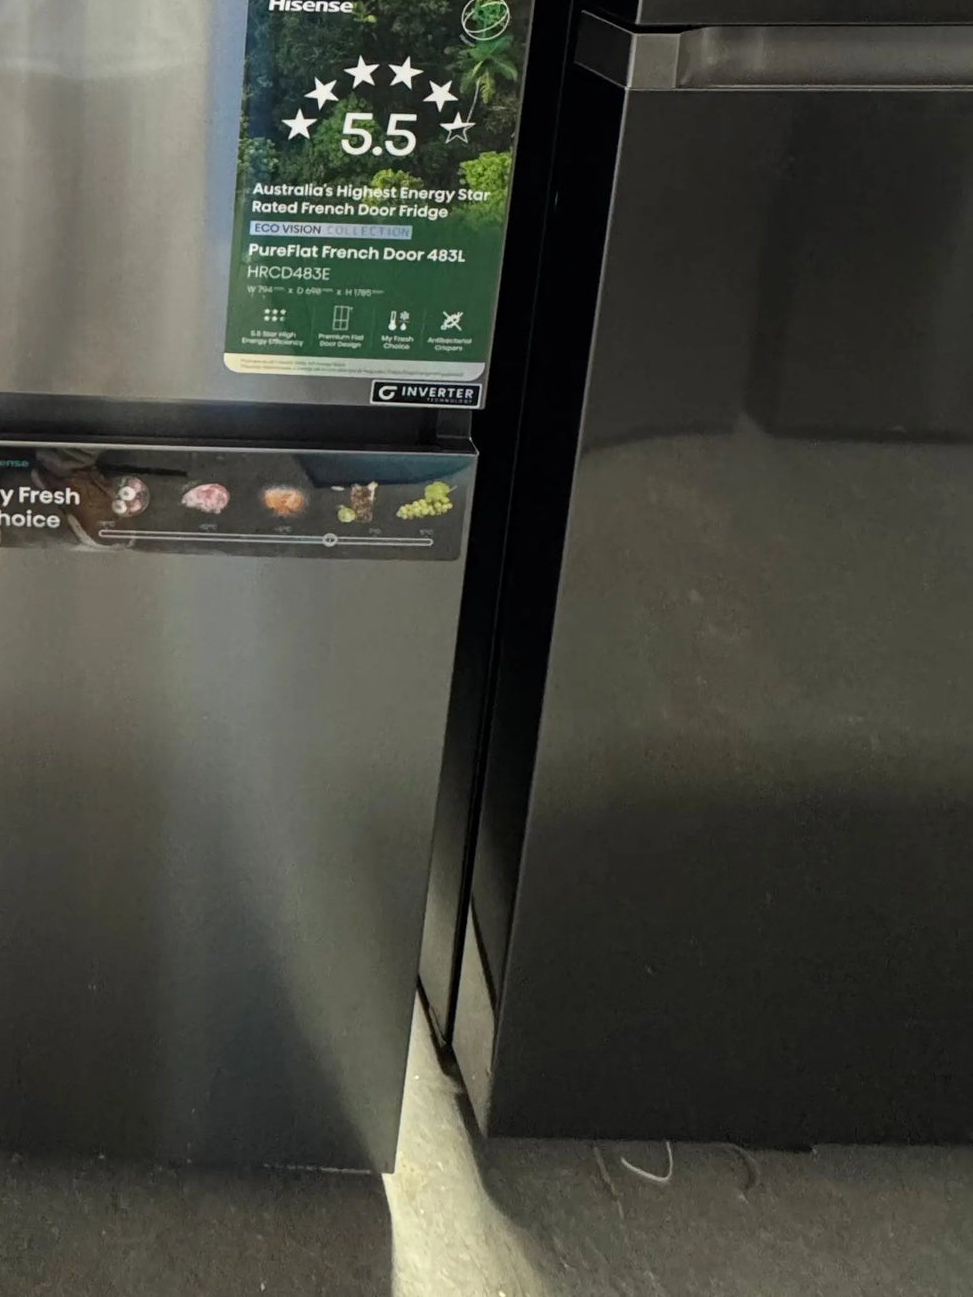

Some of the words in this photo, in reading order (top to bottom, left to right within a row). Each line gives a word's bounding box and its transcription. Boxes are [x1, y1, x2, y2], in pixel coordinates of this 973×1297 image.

[340, 112, 418, 156] 5.5
[252, 183, 333, 197] Australia's
[336, 184, 397, 201] Highest
[400, 187, 455, 203] Energy
[457, 188, 491, 201] Star
[252, 200, 298, 214] Rated
[301, 202, 355, 215] French
[358, 203, 396, 217] Door
[399, 204, 449, 221] Fridge
[254, 223, 279, 233] ECO
[282, 223, 322, 234] VISION
[327, 225, 410, 237] COLLECTION
[248, 243, 319, 258] PureFlat
[322, 245, 380, 260] French
[383, 247, 425, 261] Door
[427, 248, 466, 262] 483L
[247, 265, 331, 280] HRCD483E
[401, 386, 474, 399] INVERTER
[19, 486, 81, 506] Fresh
